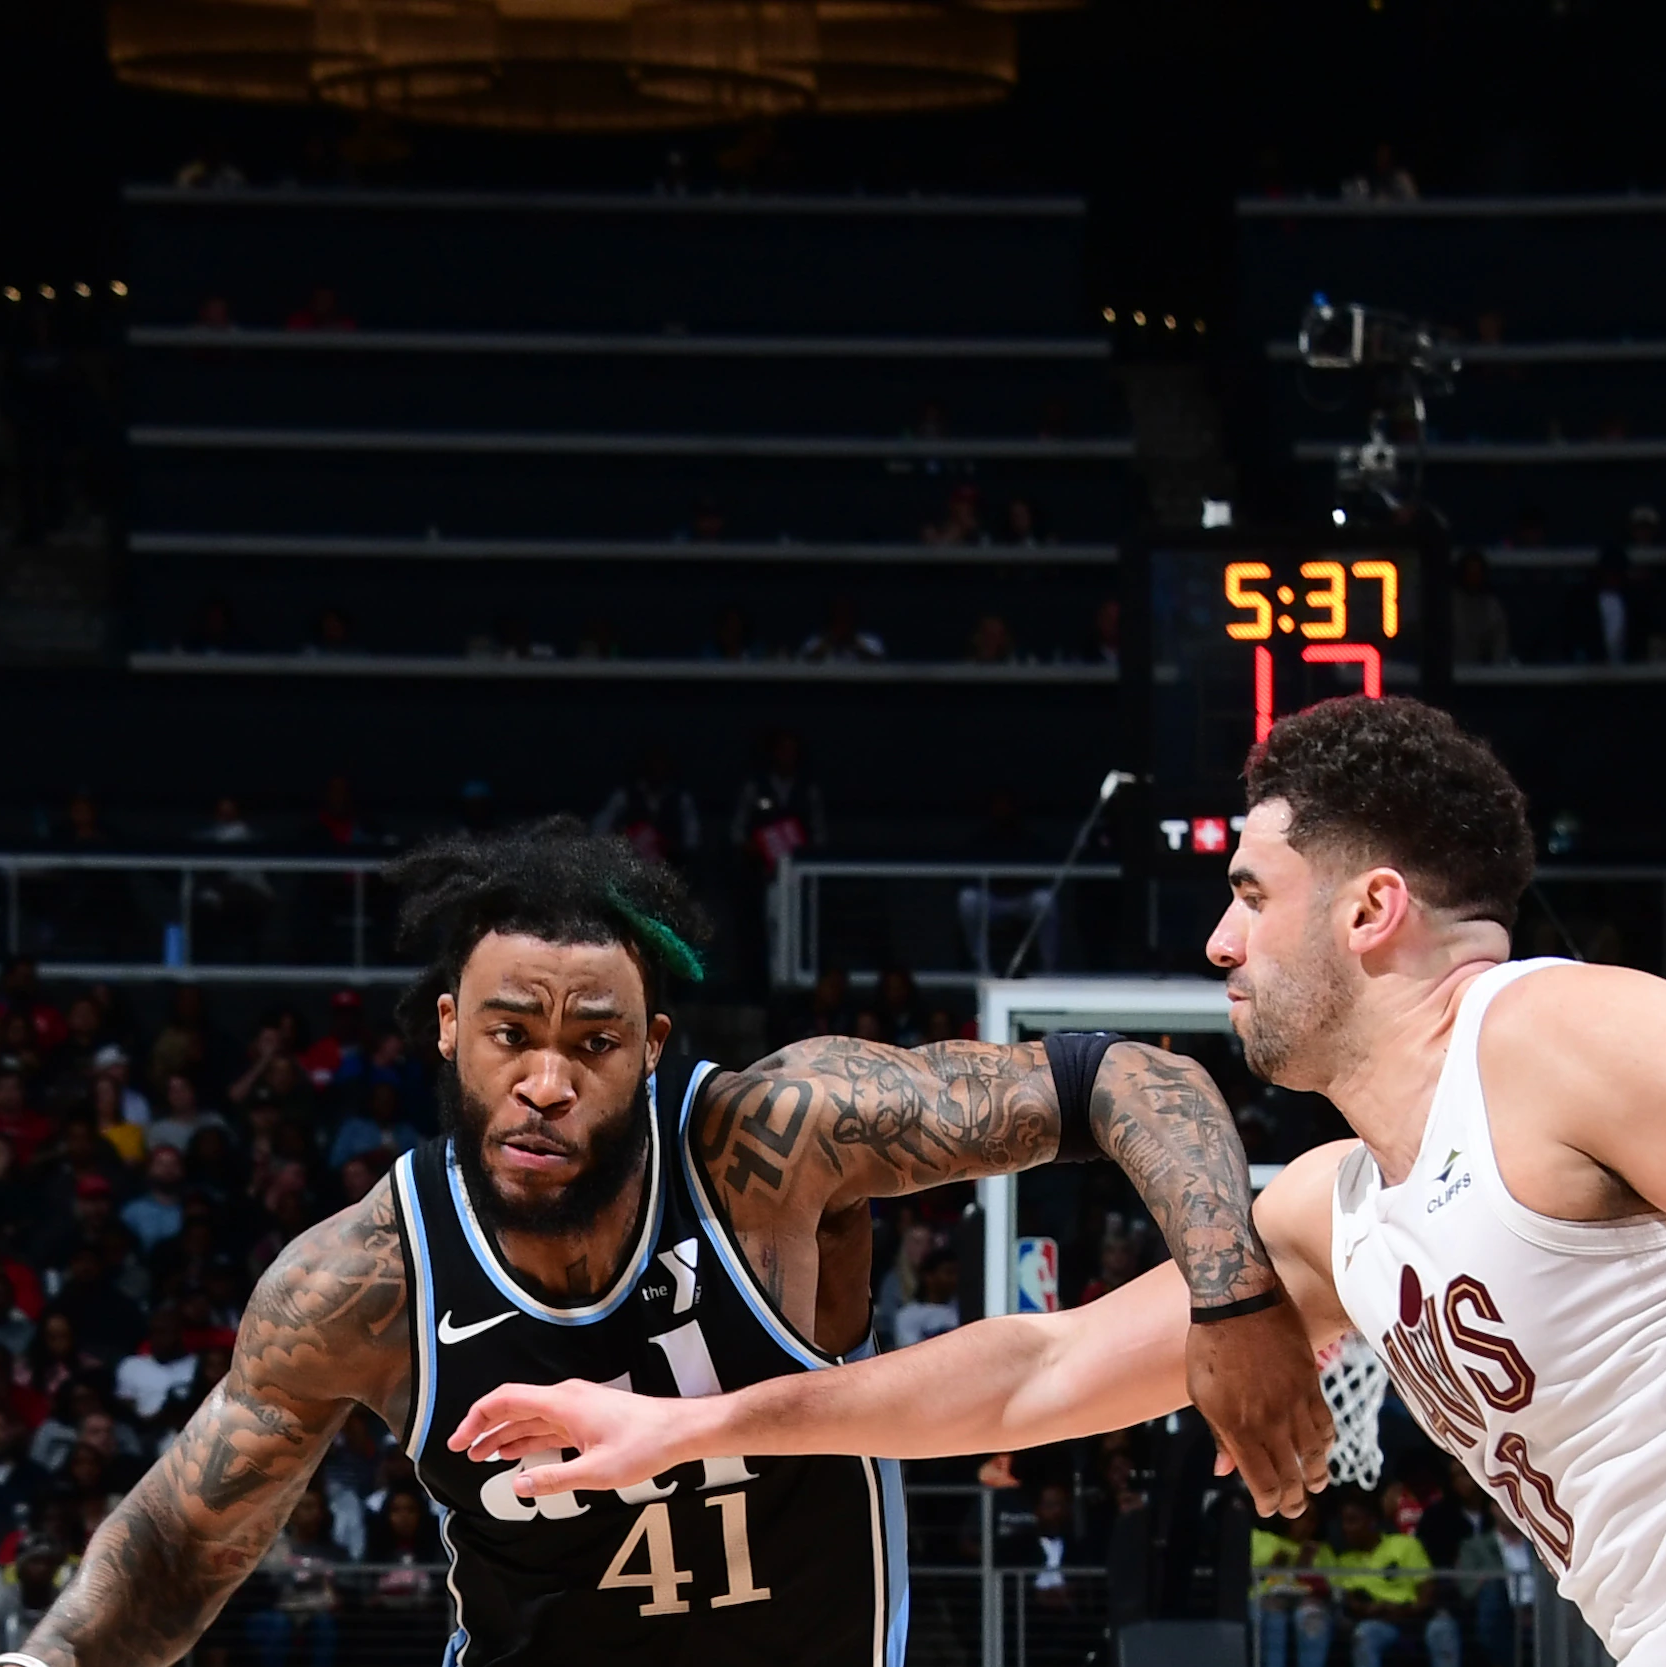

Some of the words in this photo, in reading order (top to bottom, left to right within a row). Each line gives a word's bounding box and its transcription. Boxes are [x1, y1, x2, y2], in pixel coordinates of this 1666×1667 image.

[1225, 562, 1398, 640] 5:37
[1427, 1172, 1471, 1213] CLIFFS
[641, 1285, 668, 1301] the
[471, 1319, 761, 1522] al
[596, 1491, 772, 1617] 41
